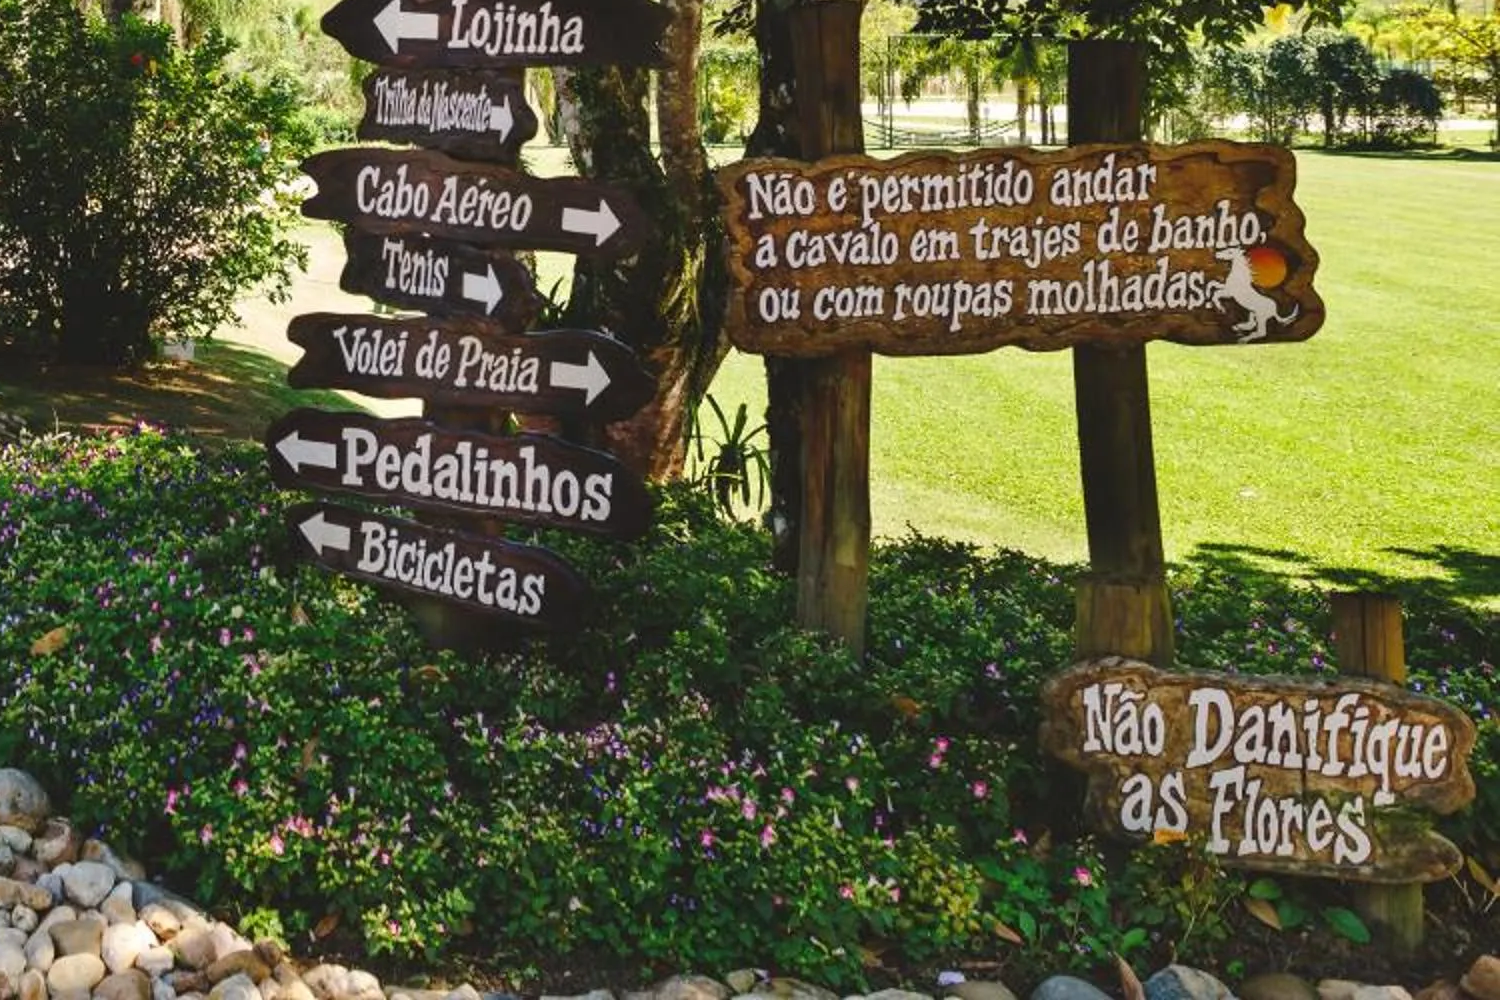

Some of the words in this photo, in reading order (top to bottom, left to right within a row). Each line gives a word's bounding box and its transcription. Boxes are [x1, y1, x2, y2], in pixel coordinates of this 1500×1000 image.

[375, 75, 417, 126] Trilha
[429, 80, 492, 134] Nascente
[356, 163, 430, 220] Cabo
[429, 178, 533, 231] Aéreo
[746, 171, 815, 219] Não
[858, 160, 1034, 228] permitido
[1050, 153, 1157, 207] andar
[382, 238, 449, 297] Tenis
[755, 233, 778, 268] a
[910, 228, 961, 263] em
[970, 217, 1081, 269] trajes
[1097, 206, 1139, 254] de
[1150, 200, 1267, 252] banho,
[759, 286, 801, 323] ou
[813, 285, 884, 321] com
[893, 279, 1013, 332] roupas
[333, 325, 410, 376] Volei
[415, 329, 451, 379] de
[453, 335, 540, 393] Praia
[341, 427, 613, 522] Pedalinhos
[357, 521, 546, 617] Bicicletas
[1082, 682, 1165, 757] Não
[1187, 687, 1448, 806] Danifique
[1120, 771, 1190, 834] as
[1206, 765, 1372, 865] Flores
